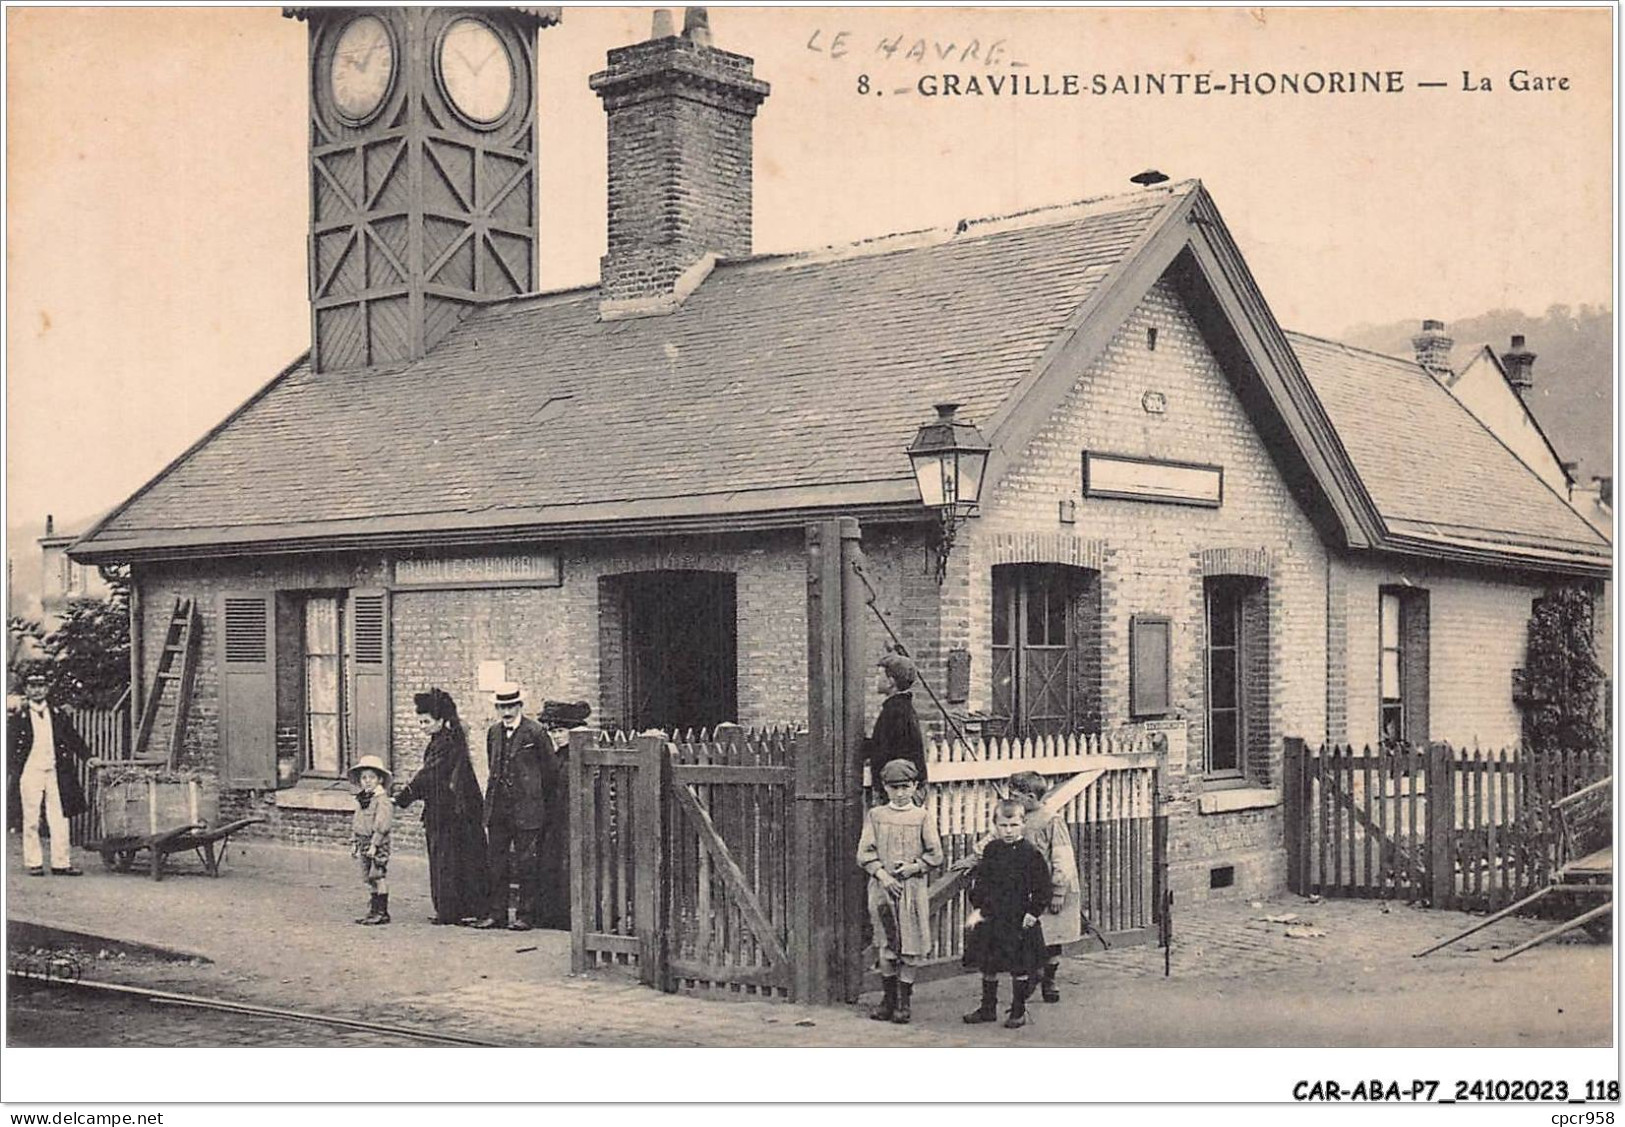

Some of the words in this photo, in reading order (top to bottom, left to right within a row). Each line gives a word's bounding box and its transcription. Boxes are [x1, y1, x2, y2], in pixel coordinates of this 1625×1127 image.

[806, 29, 850, 59] LE
[876, 34, 1007, 66] HAVRE
[857, 74, 883, 97] 8.
[917, 71, 1404, 97] GRAVILLE-SAINTE-HONORINE
[1462, 70, 1493, 92] La
[1509, 69, 1571, 92] Gare
